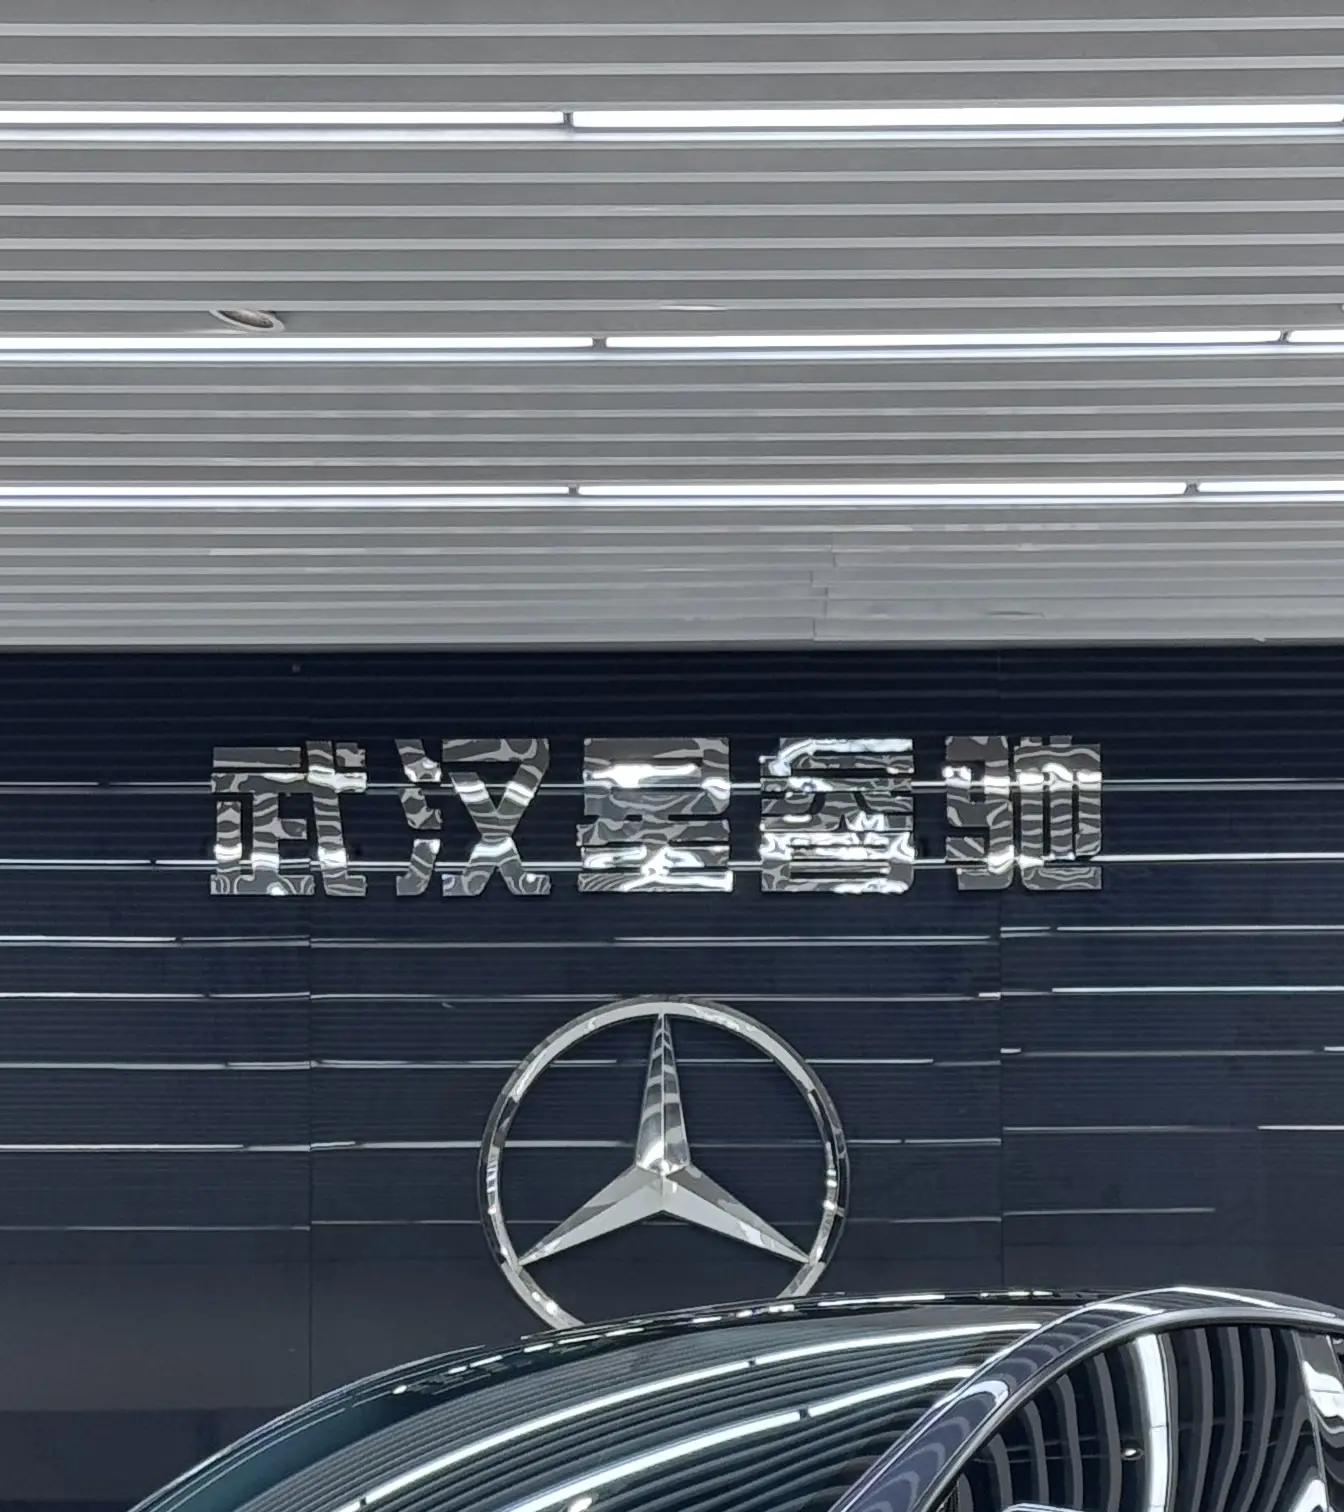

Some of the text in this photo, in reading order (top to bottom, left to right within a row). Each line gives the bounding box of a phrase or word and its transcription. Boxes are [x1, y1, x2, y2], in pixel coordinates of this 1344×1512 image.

[210, 735, 1102, 896] 武汉星睿驰
